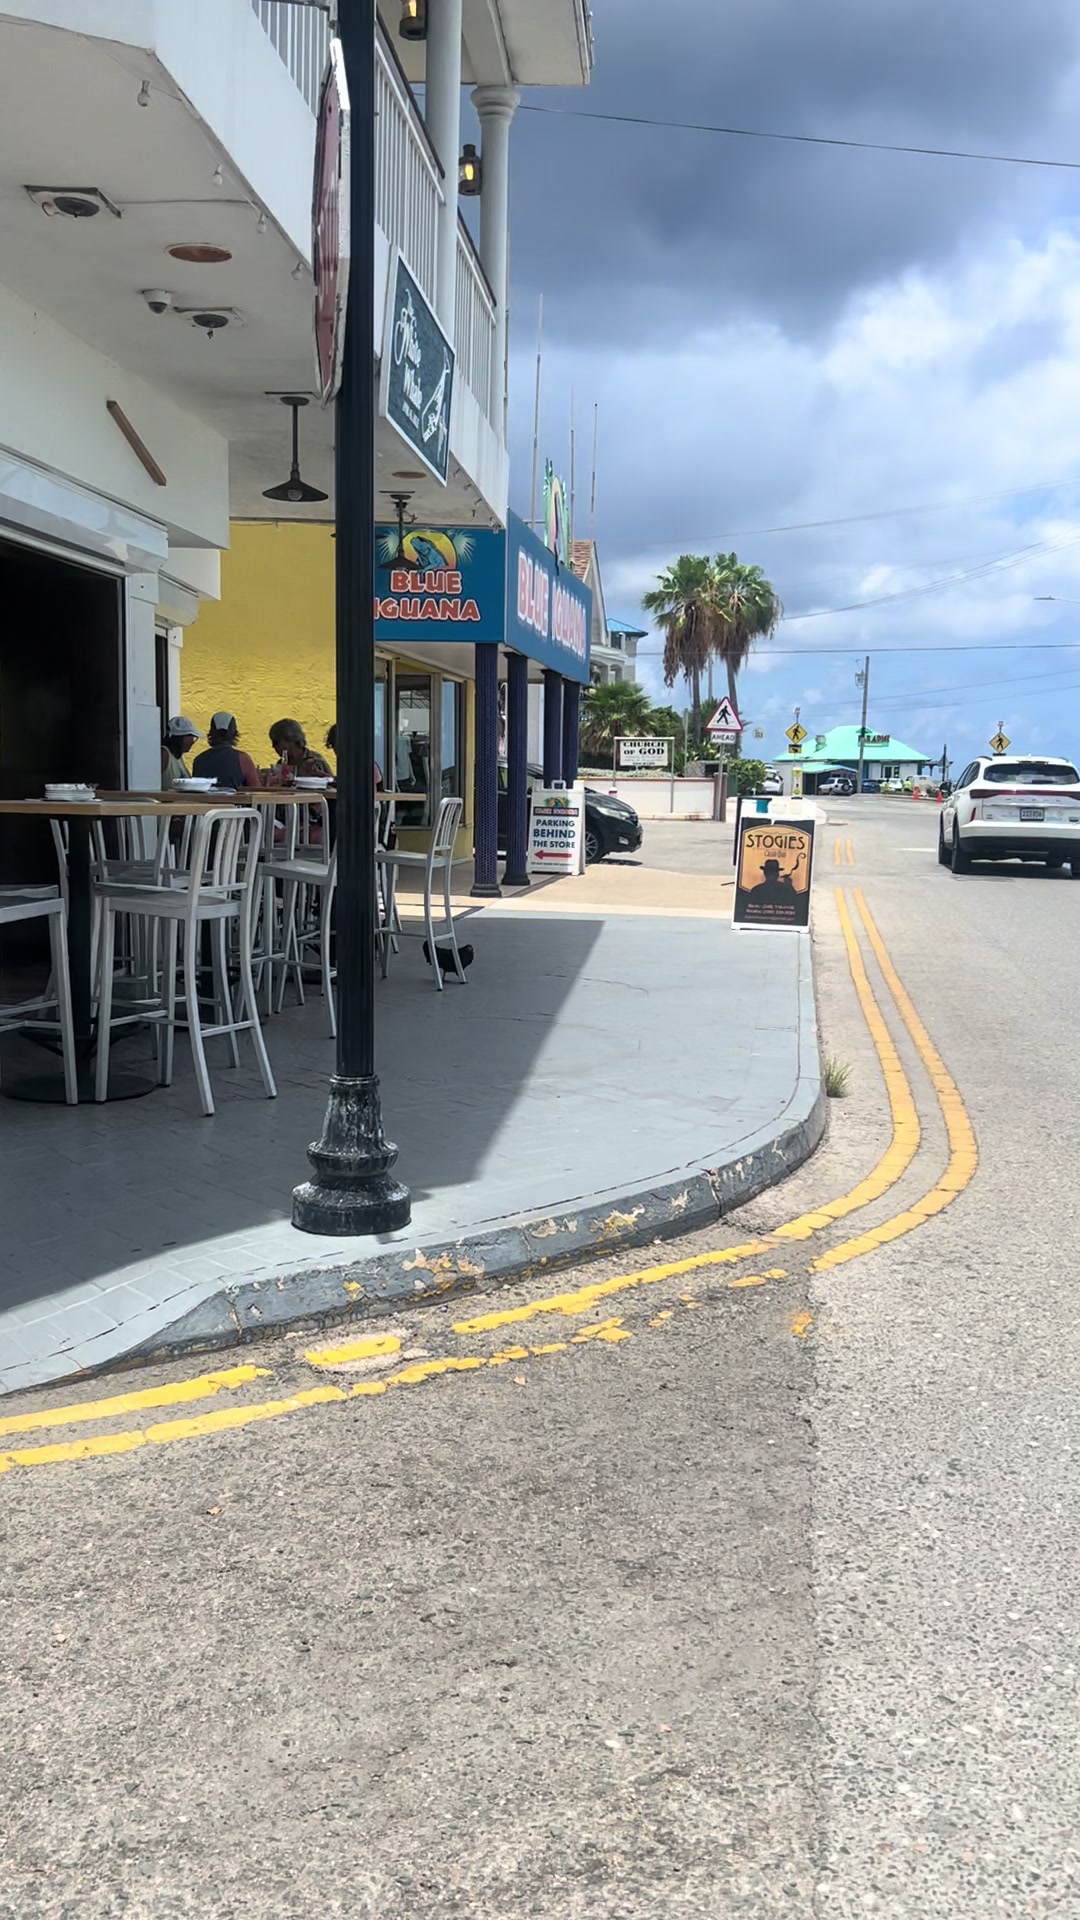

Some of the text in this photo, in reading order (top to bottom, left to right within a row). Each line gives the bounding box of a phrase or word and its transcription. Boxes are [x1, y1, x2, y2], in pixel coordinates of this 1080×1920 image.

[390, 570, 462, 594] BLUE
[517, 549, 549, 637] BLUE
[374, 598, 481, 622] IGUANA
[536, 819, 575, 827] PARKING
[534, 829, 575, 838] BEHIND
[746, 834, 805, 849] STOGIES
